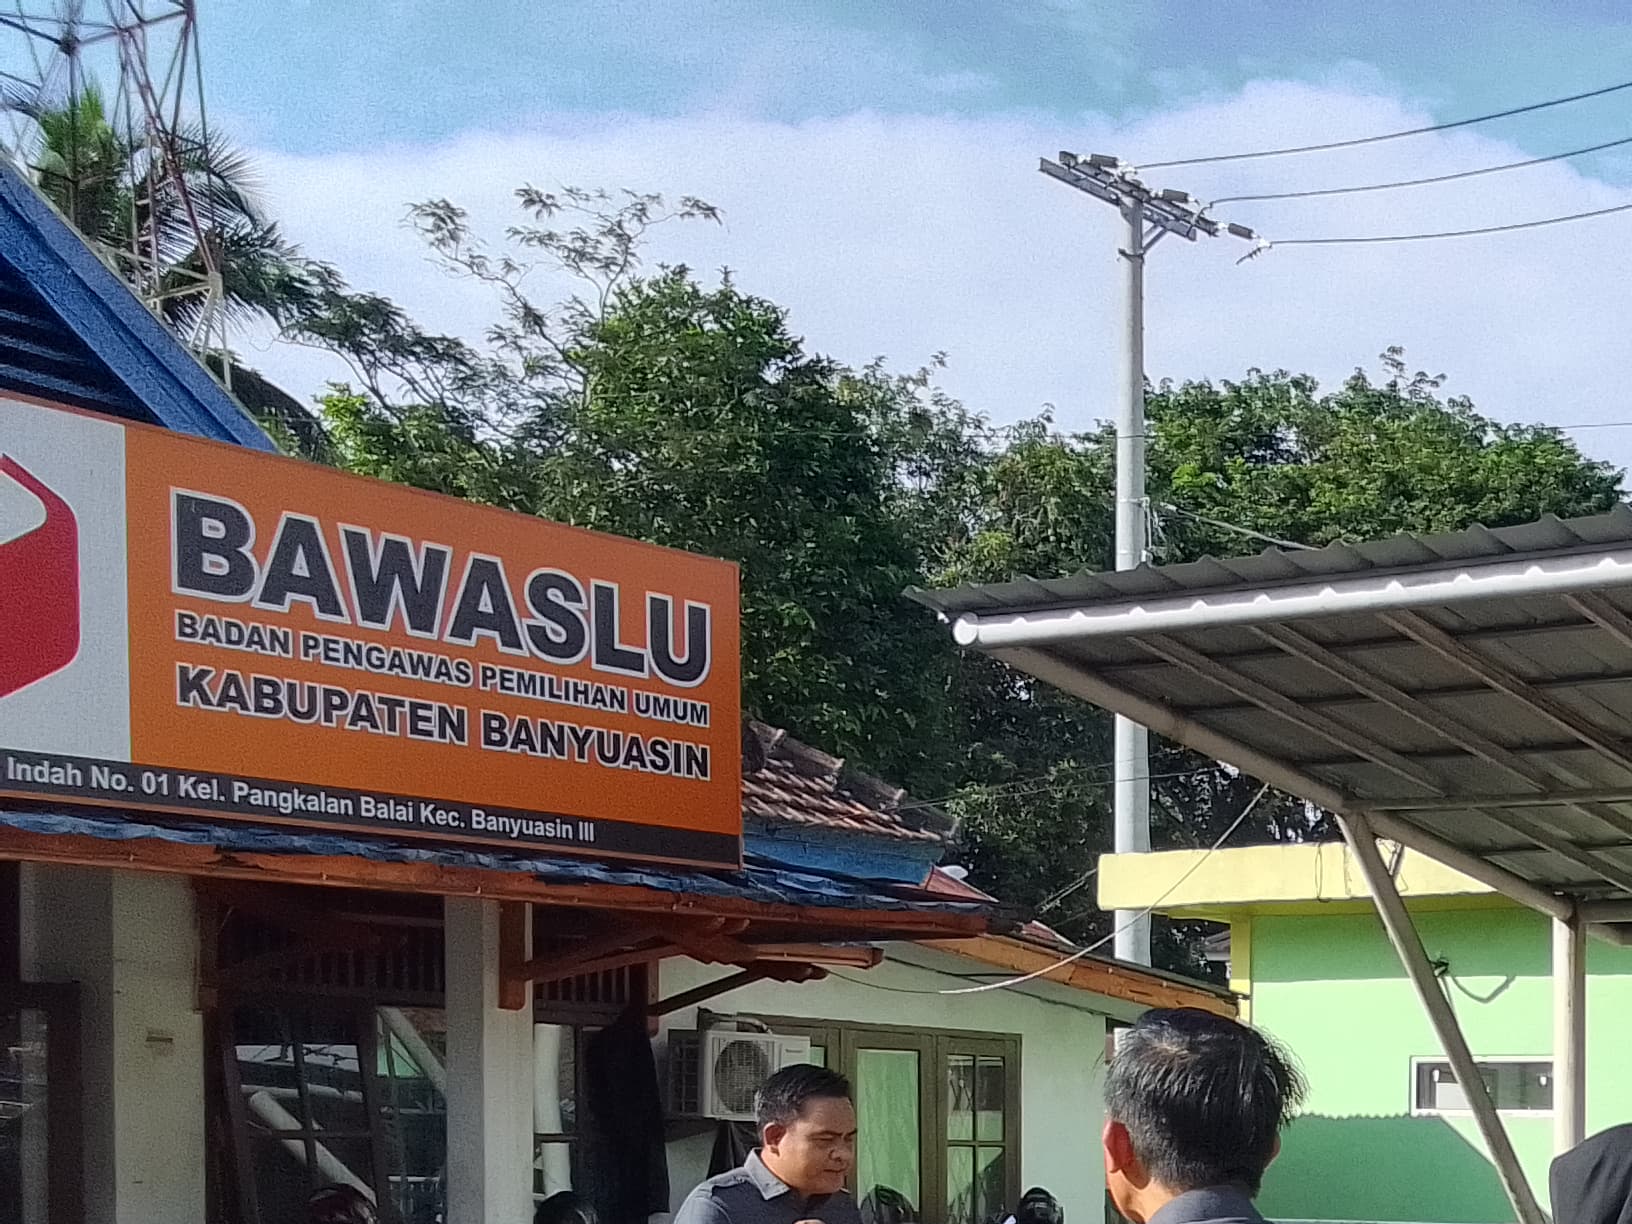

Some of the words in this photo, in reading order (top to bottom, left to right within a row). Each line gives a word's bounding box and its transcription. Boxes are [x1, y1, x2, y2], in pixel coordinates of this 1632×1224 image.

[169, 486, 712, 687] BAWASLU
[175, 609, 293, 658] BADAN
[300, 631, 473, 688] PENGAWAS
[479, 661, 628, 713] PEMILIHAN
[632, 689, 710, 728] UMUM
[176, 661, 468, 746] KABUPATEN
[480, 708, 711, 781] BANYUASIN
[7, 756, 82, 787] Indah
[90, 765, 134, 792] No.
[141, 772, 169, 795] 01
[179, 775, 225, 801] Kel.
[232, 781, 353, 815] Pangkalan
[360, 796, 413, 822] Balai
[420, 803, 465, 828] Kec.
[471, 809, 573, 840] Banyuasin
[578, 821, 595, 842] III
